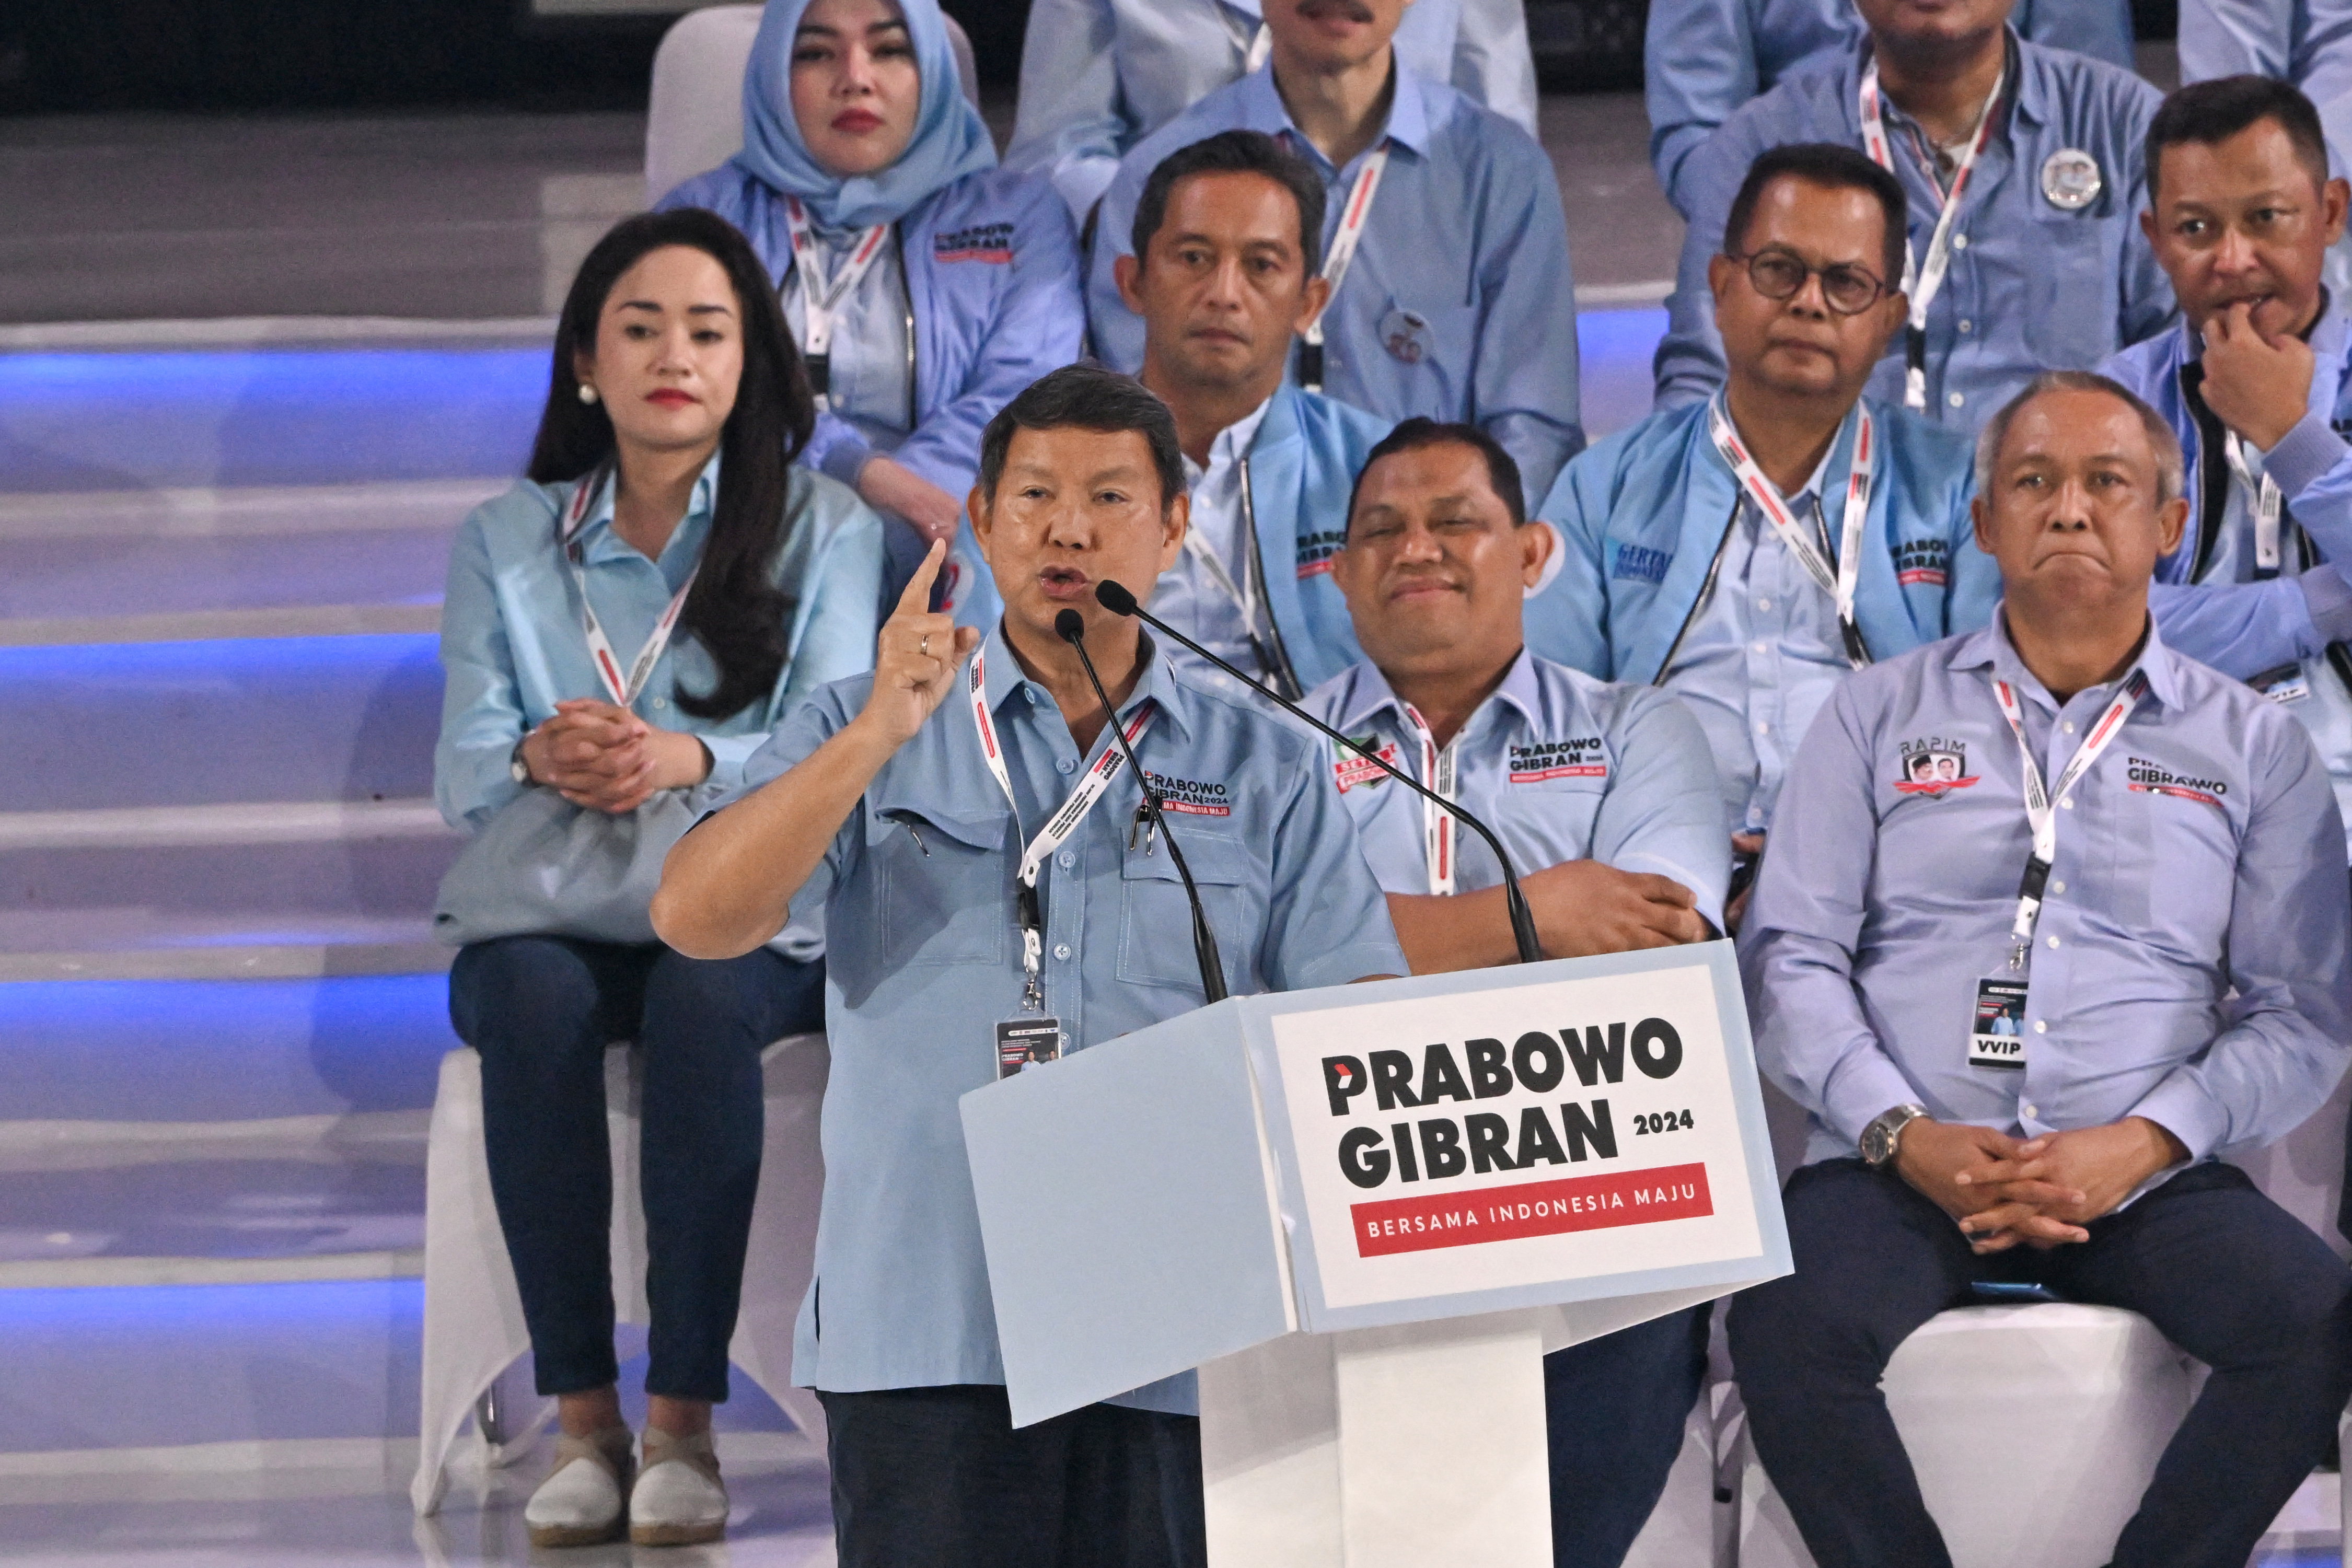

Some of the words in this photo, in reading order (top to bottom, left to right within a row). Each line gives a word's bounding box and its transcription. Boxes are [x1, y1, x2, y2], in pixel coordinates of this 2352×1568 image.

[1510, 737, 1602, 757] PRABOWO
[1900, 737, 1966, 755] RAPIM
[1102, 751, 1119, 772] GIBRAN
[1103, 754, 1125, 781] PRABOWO
[1510, 752, 1581, 771] GIBRAN
[1176, 803, 1208, 814] INDONESIA
[1978, 1040, 2021, 1054] VVIP
[1322, 1018, 1683, 1116] PRABOWO
[1338, 1099, 1618, 1188] GIBRAN
[1633, 1109, 1694, 1135] 2024
[1368, 1211, 1478, 1238] BERSAMA
[1490, 1193, 1624, 1223] INDONESIA
[1635, 1183, 1696, 1204] MAJU
